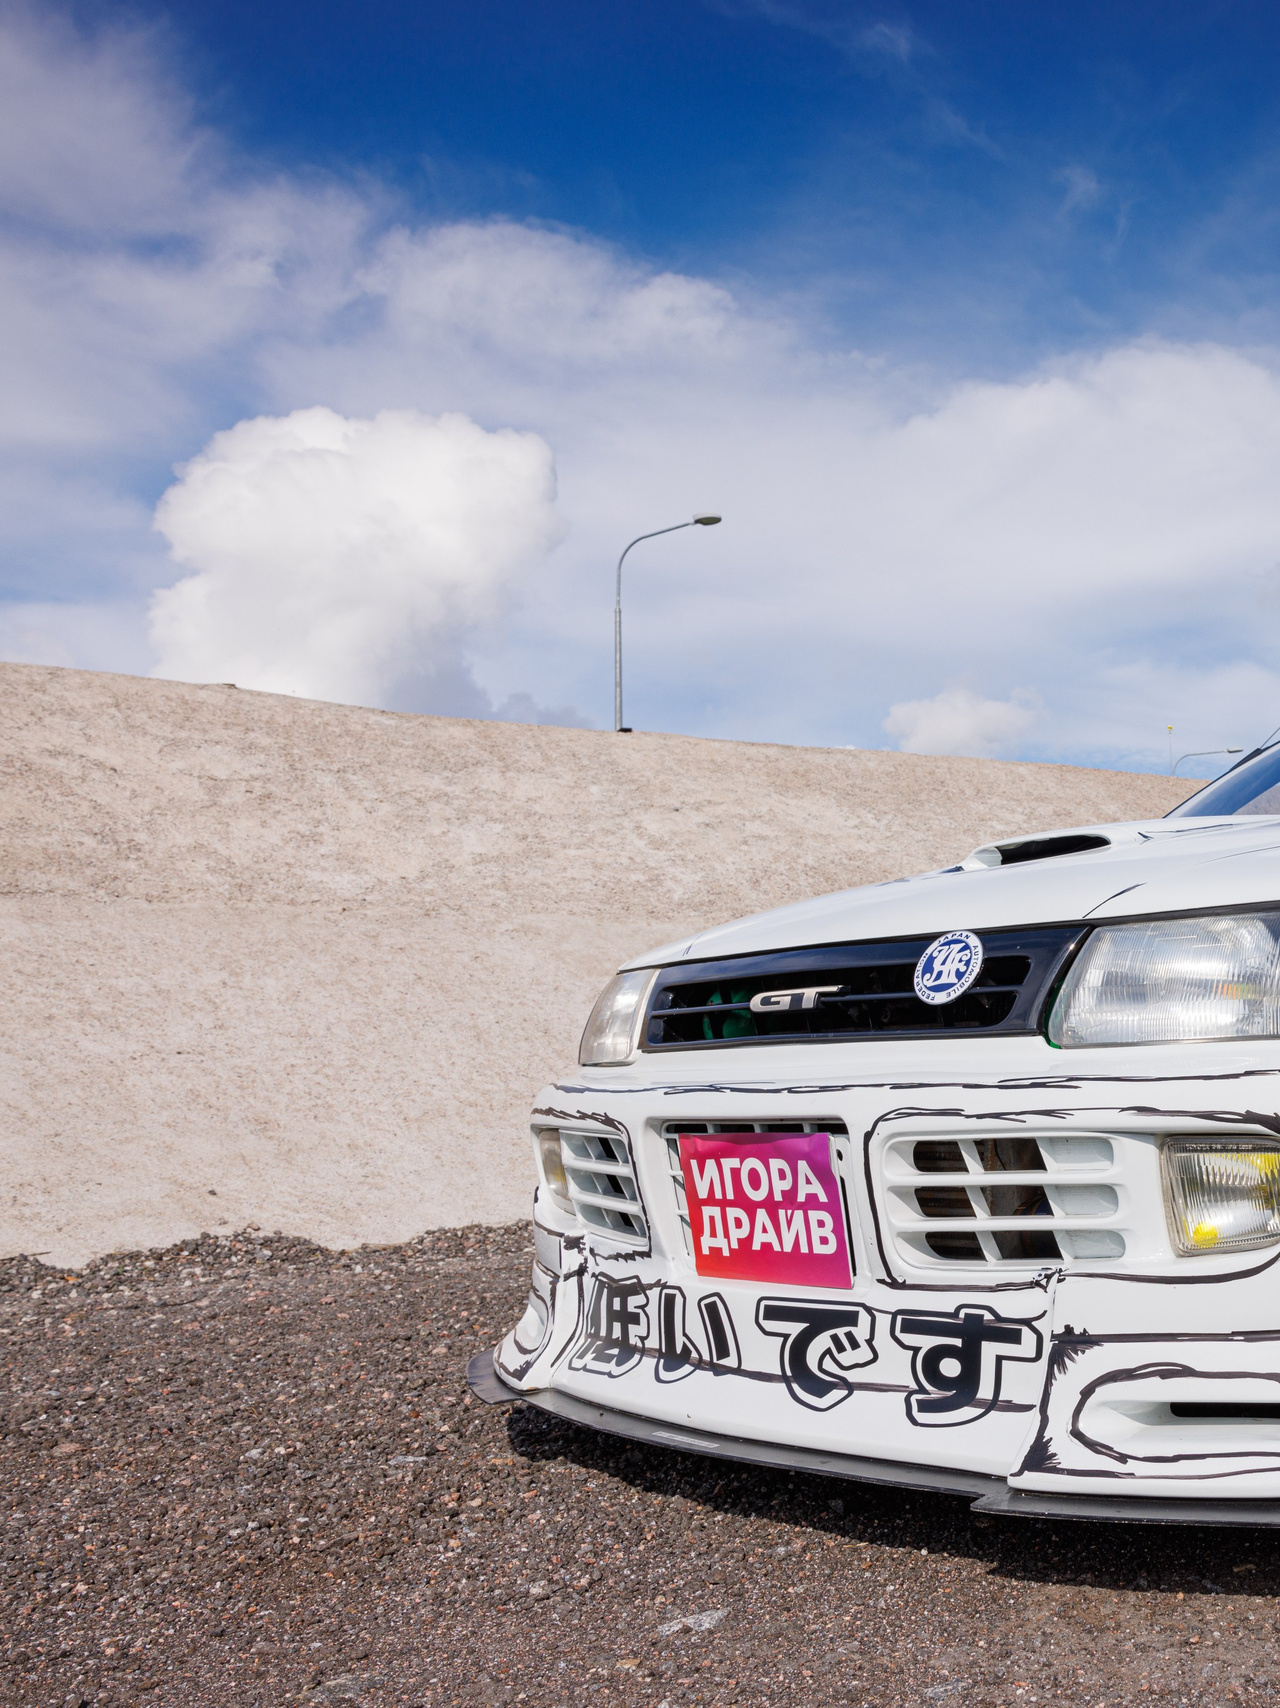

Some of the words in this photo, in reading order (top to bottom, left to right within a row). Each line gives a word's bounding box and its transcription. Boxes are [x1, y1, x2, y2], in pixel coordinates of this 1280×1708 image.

[937, 932, 971, 945] JAPAN
[915, 952, 936, 1002] FEDERATION
[945, 945, 980, 999] AUTOMOBILE
[749, 984, 846, 1012] GT
[690, 1157, 829, 1204] ИГОРА
[699, 1205, 839, 1257] ДРАЙВ
[570, 1272, 1045, 1427] 低いです
